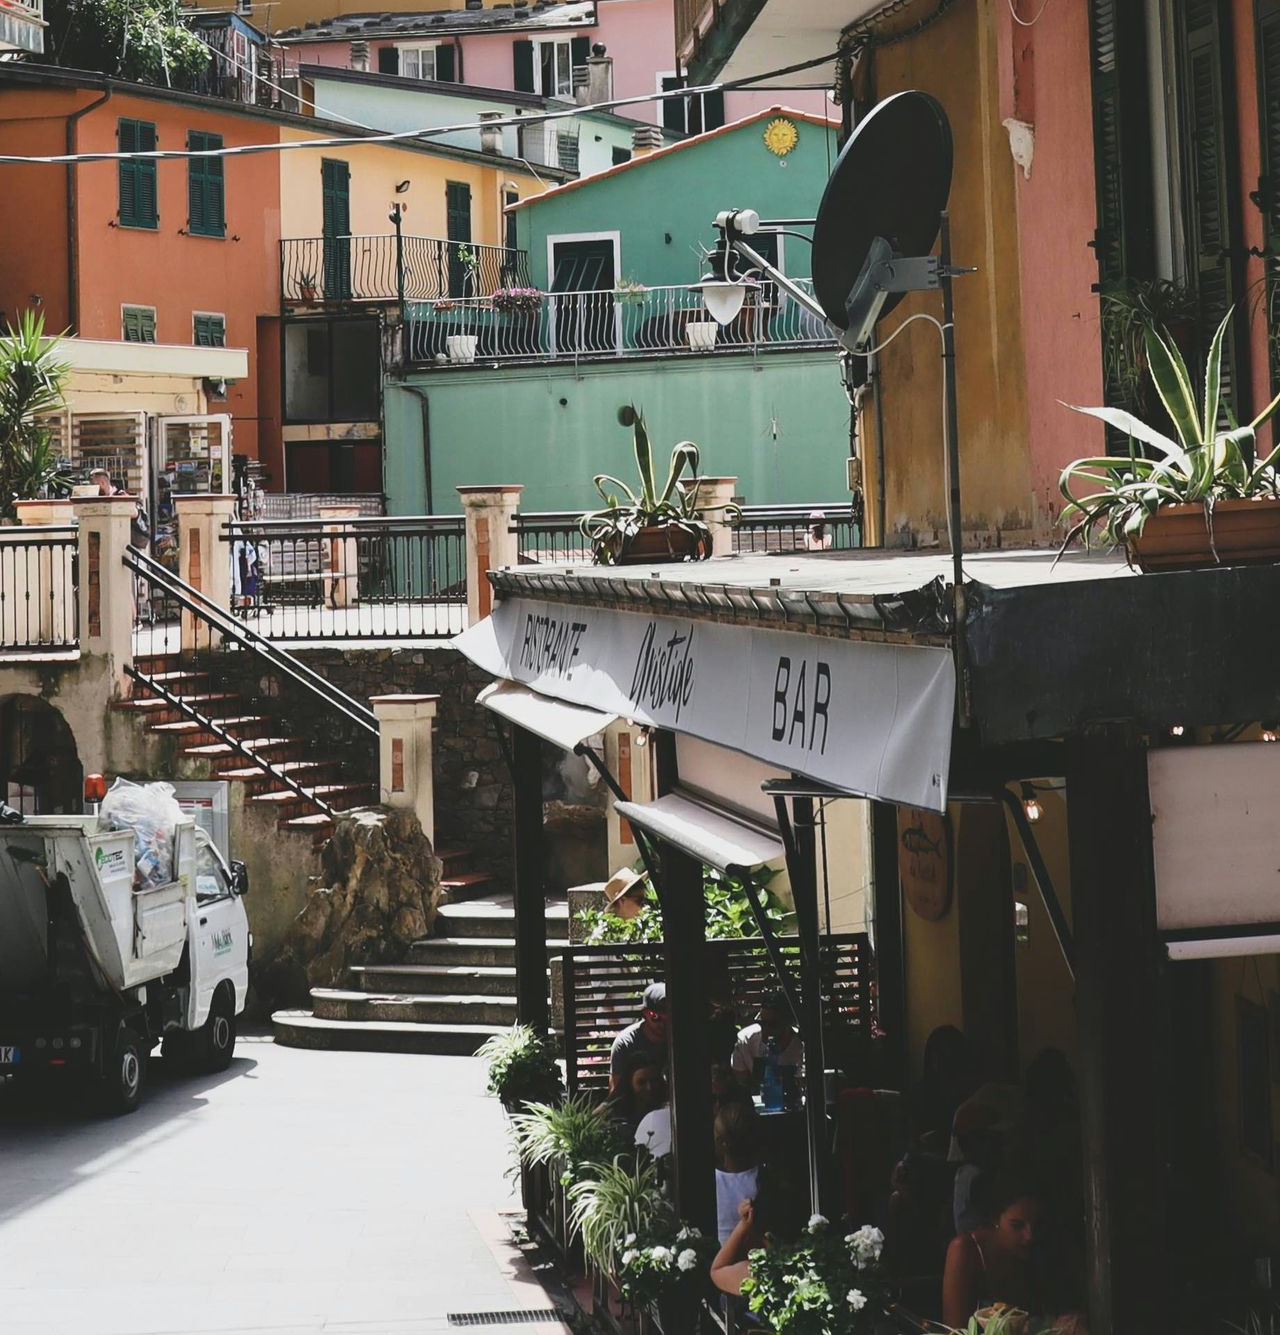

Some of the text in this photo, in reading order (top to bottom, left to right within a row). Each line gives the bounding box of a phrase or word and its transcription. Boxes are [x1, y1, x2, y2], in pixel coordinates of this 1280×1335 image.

[519, 613, 588, 681] RISTORANTE
[628, 621, 695, 724] Aristide
[772, 655, 832, 756] BAR
